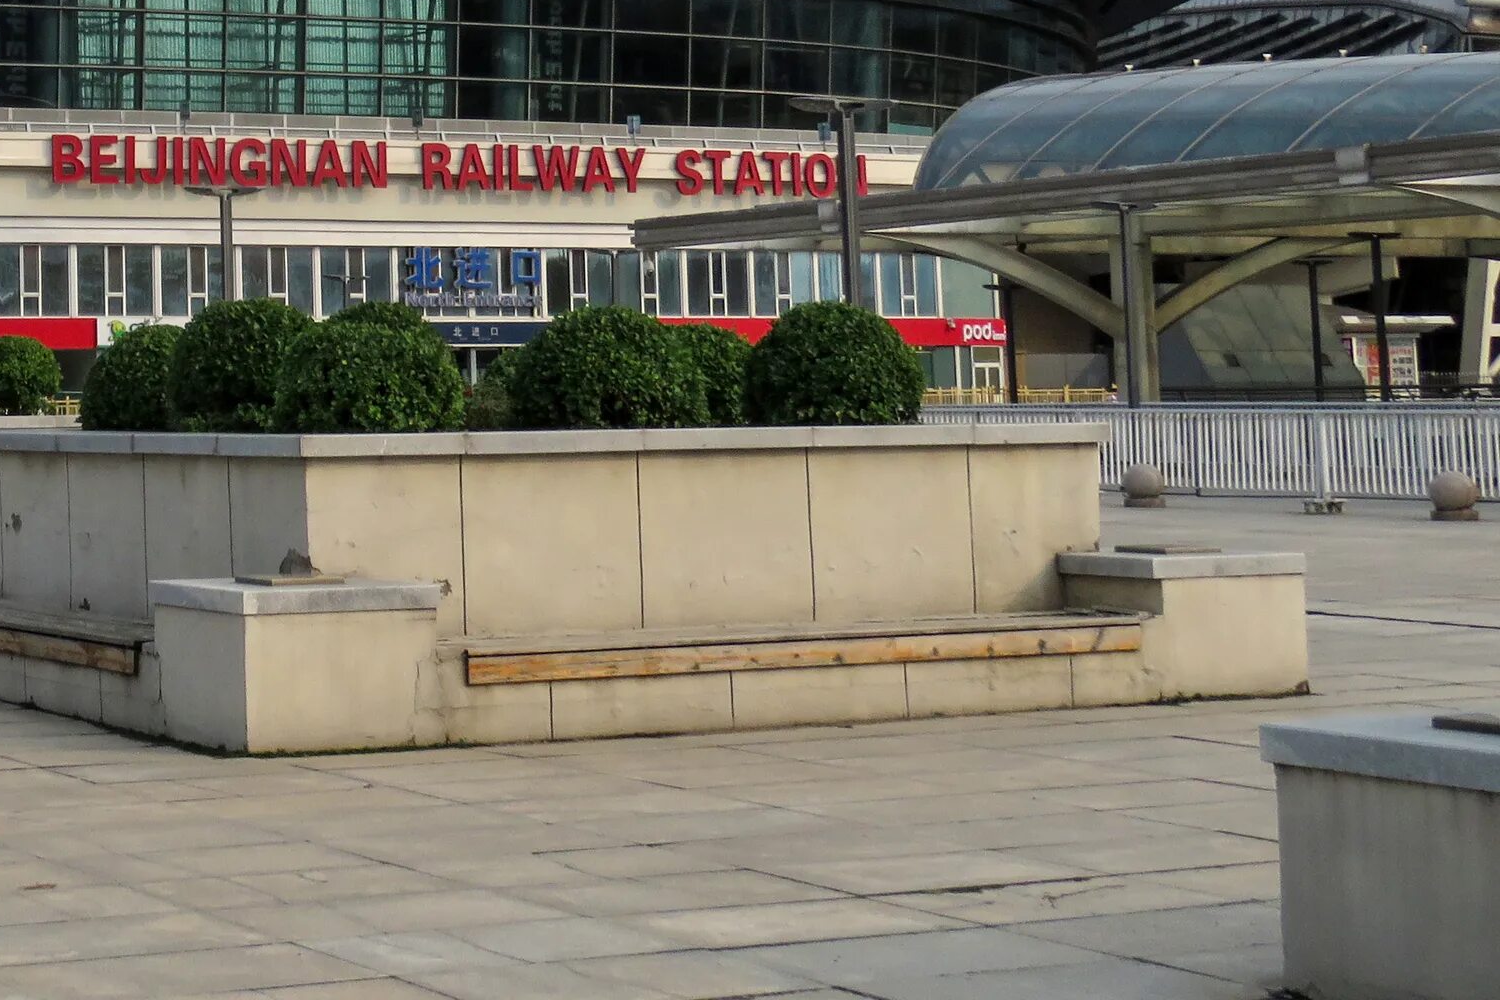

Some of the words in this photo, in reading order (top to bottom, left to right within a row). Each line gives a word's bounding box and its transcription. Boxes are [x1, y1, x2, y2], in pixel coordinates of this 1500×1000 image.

[51, 133, 388, 189] BEIJINGNAN
[421, 141, 646, 193] RAILWAY
[404, 246, 542, 289] 北进口
[404, 291, 455, 308] North
[463, 291, 543, 308] Entrance
[963, 322, 992, 343] pod
